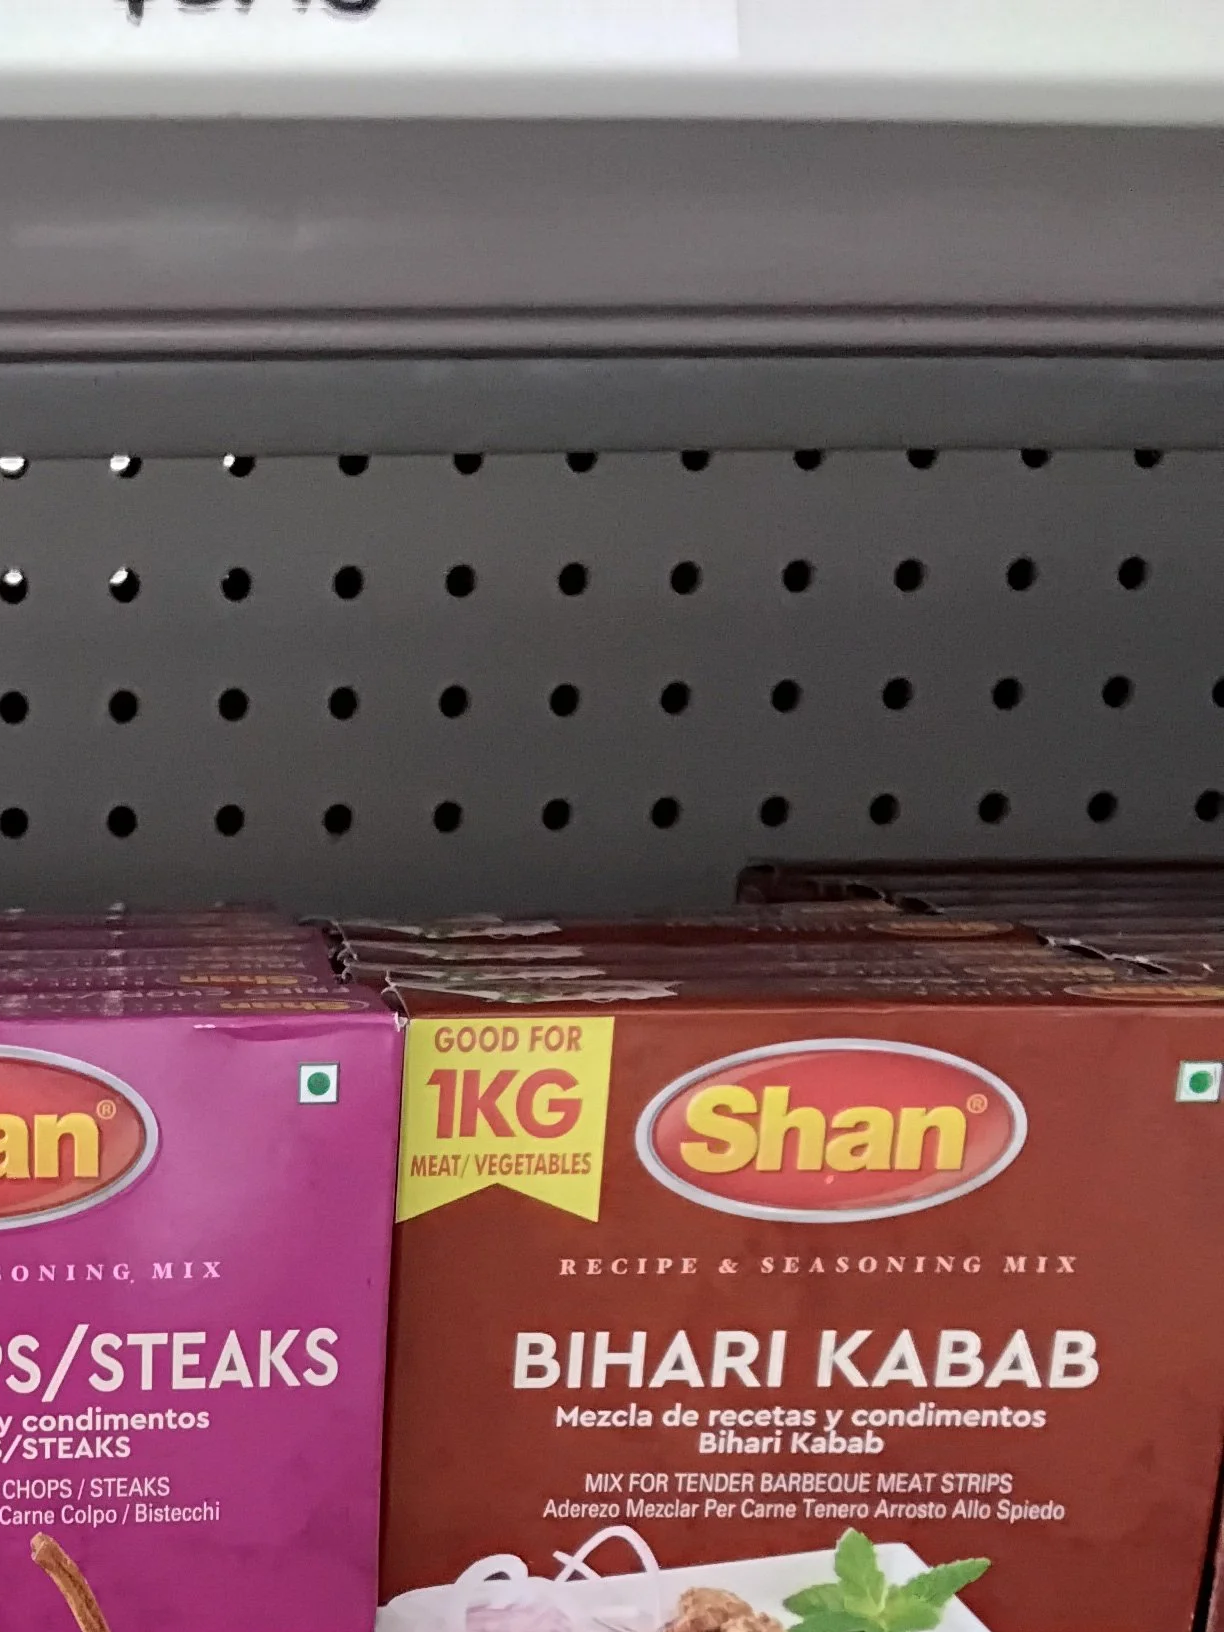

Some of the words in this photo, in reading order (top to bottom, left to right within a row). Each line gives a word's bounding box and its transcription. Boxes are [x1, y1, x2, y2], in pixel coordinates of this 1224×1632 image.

[434, 1026, 519, 1053] GOOD
[529, 1025, 582, 1052] FOR
[425, 1069, 582, 1139] 1KG
[678, 1082, 971, 1173] Shan
[410, 1155, 469, 1177] MEAT/
[474, 1152, 591, 1176] VEGETABLES
[152, 1262, 220, 1279] MIX
[560, 1258, 697, 1275] RECIPE
[719, 1259, 738, 1273] &
[761, 1256, 980, 1273] SEASONING
[1004, 1256, 1076, 1273] MIX
[513, 1330, 786, 1388] BIHARI
[817, 1329, 1099, 1388] KABAB
[23, 1407, 209, 1432] condimentos
[556, 1403, 652, 1427] Mezcla
[662, 1403, 699, 1427] de
[708, 1406, 816, 1427] recetas
[824, 1410, 844, 1433] y
[851, 1402, 1046, 1427] condimentos
[699, 1430, 782, 1453] Bihari
[791, 1429, 884, 1453] Kabab
[3, 1479, 72, 1499] CHOPS
[77, 1479, 87, 1500] /
[91, 1477, 169, 1497] STEAKS
[585, 1473, 624, 1492] MIX
[629, 1473, 668, 1492] FOR
[675, 1473, 754, 1492] TENDER
[760, 1472, 871, 1493] BARBEQUE
[877, 1473, 938, 1493] MEAT
[941, 1473, 1013, 1494] STRIPS
[0, 1506, 54, 1525] Carne
[62, 1505, 117, 1528] Colpo
[121, 1505, 130, 1525] /
[136, 1501, 219, 1522] Bistecchi
[543, 1499, 620, 1518] Aderezo
[626, 1498, 699, 1518] Mezclar
[704, 1499, 736, 1518] Per
[741, 1498, 796, 1518] Carne
[803, 1498, 869, 1518] Tenero
[874, 1499, 947, 1519] Arrosto
[952, 1499, 991, 1519] Allo
[997, 1499, 1065, 1523] Spiedo
